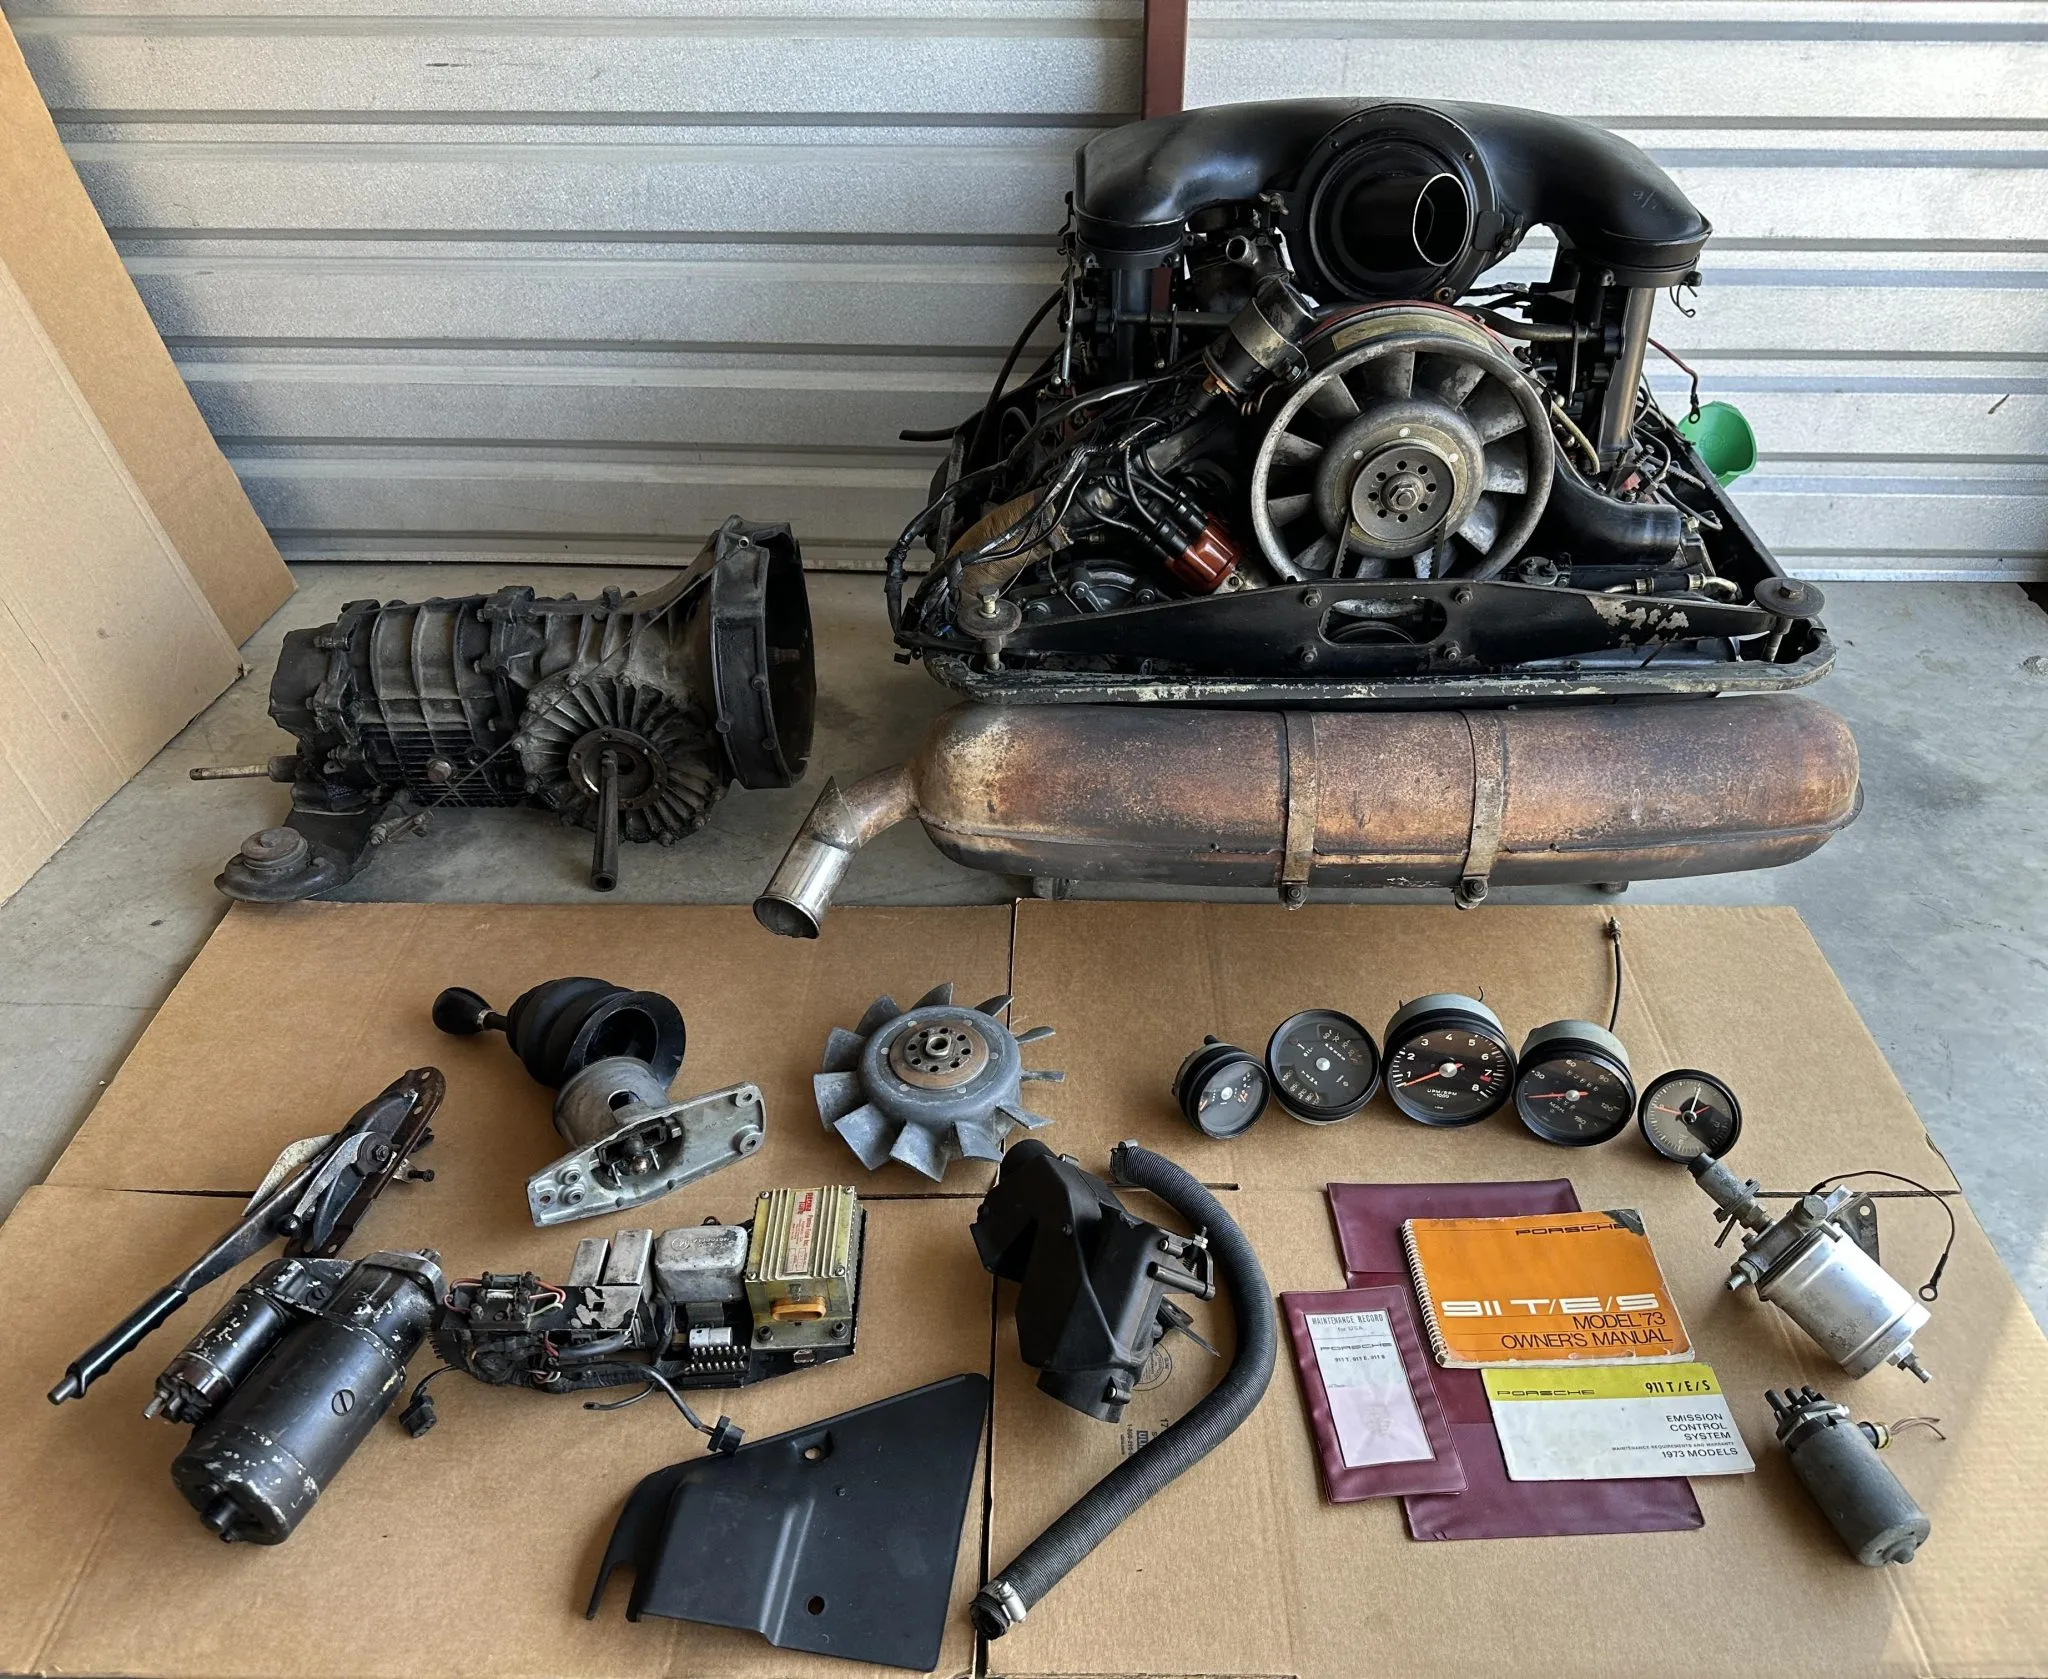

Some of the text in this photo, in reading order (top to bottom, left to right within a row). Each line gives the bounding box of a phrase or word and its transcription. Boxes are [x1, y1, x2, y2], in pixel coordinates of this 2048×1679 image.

[1445, 1033, 1453, 1041] 4
[1420, 1038, 1429, 1046] 3
[1468, 1038, 1476, 1047] 5
[1406, 1052, 1416, 1061] 2
[1481, 1053, 1489, 1061] 6
[1565, 1059, 1577, 1068] 60
[1484, 1068, 1493, 1076] 7
[1534, 1071, 1546, 1080] 30
[1598, 1074, 1610, 1083] 90
[1471, 1083, 1480, 1092] 8
[1600, 1102, 1614, 1112] 120
[1515, 1223, 1629, 1236] PORSCHE
[1441, 1300, 1503, 1317] 911
[1311, 1313, 1384, 1325] MAINTENANCE RECORD
[1573, 1312, 1635, 1330] MODEL
[1501, 1328, 1674, 1350] OWNER'S MANUAL
[1320, 1342, 1393, 1351] PORSCHE
[1645, 1382, 1664, 1394] 911
[1497, 1389, 1596, 1397] PORSCHE
[1665, 1412, 1723, 1422] EMISSION
[1669, 1422, 1728, 1432] CONTROL
[1684, 1431, 1731, 1441] SYSTEM
[1662, 1447, 1739, 1459] 1973 MODELS
